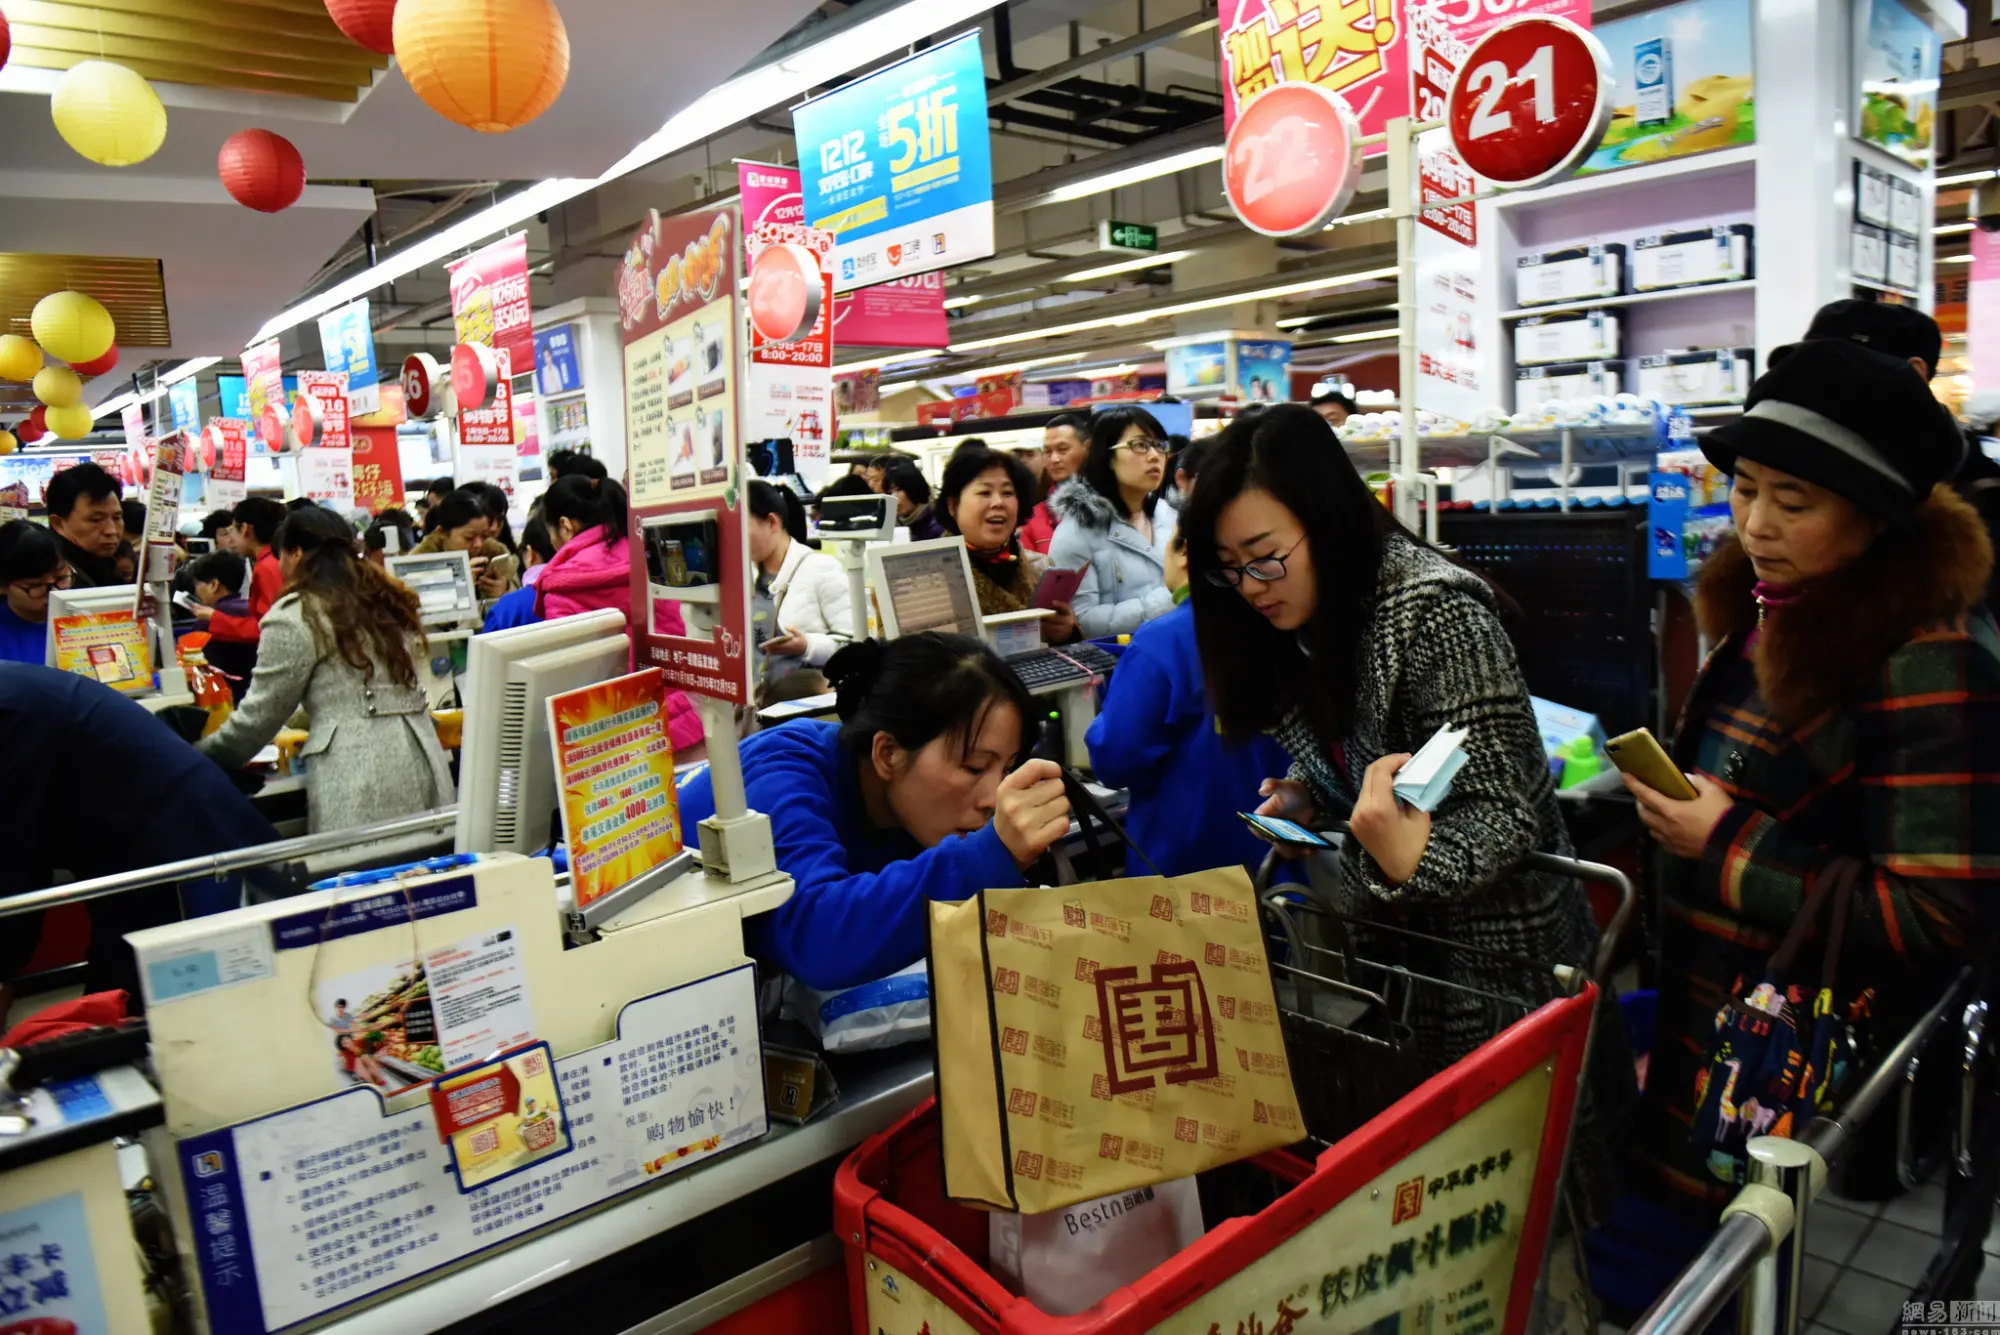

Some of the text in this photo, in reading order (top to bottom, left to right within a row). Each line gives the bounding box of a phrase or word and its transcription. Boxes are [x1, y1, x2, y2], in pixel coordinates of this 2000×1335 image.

[1466, 45, 1557, 141] 21
[887, 85, 958, 173] 5折
[820, 130, 866, 174] 1212
[1234, 115, 1318, 205] 22
[761, 350, 823, 363] 8:00-20:00
[572, 1135, 597, 1149] 白色
[1064, 1199, 1123, 1236] Bestn
